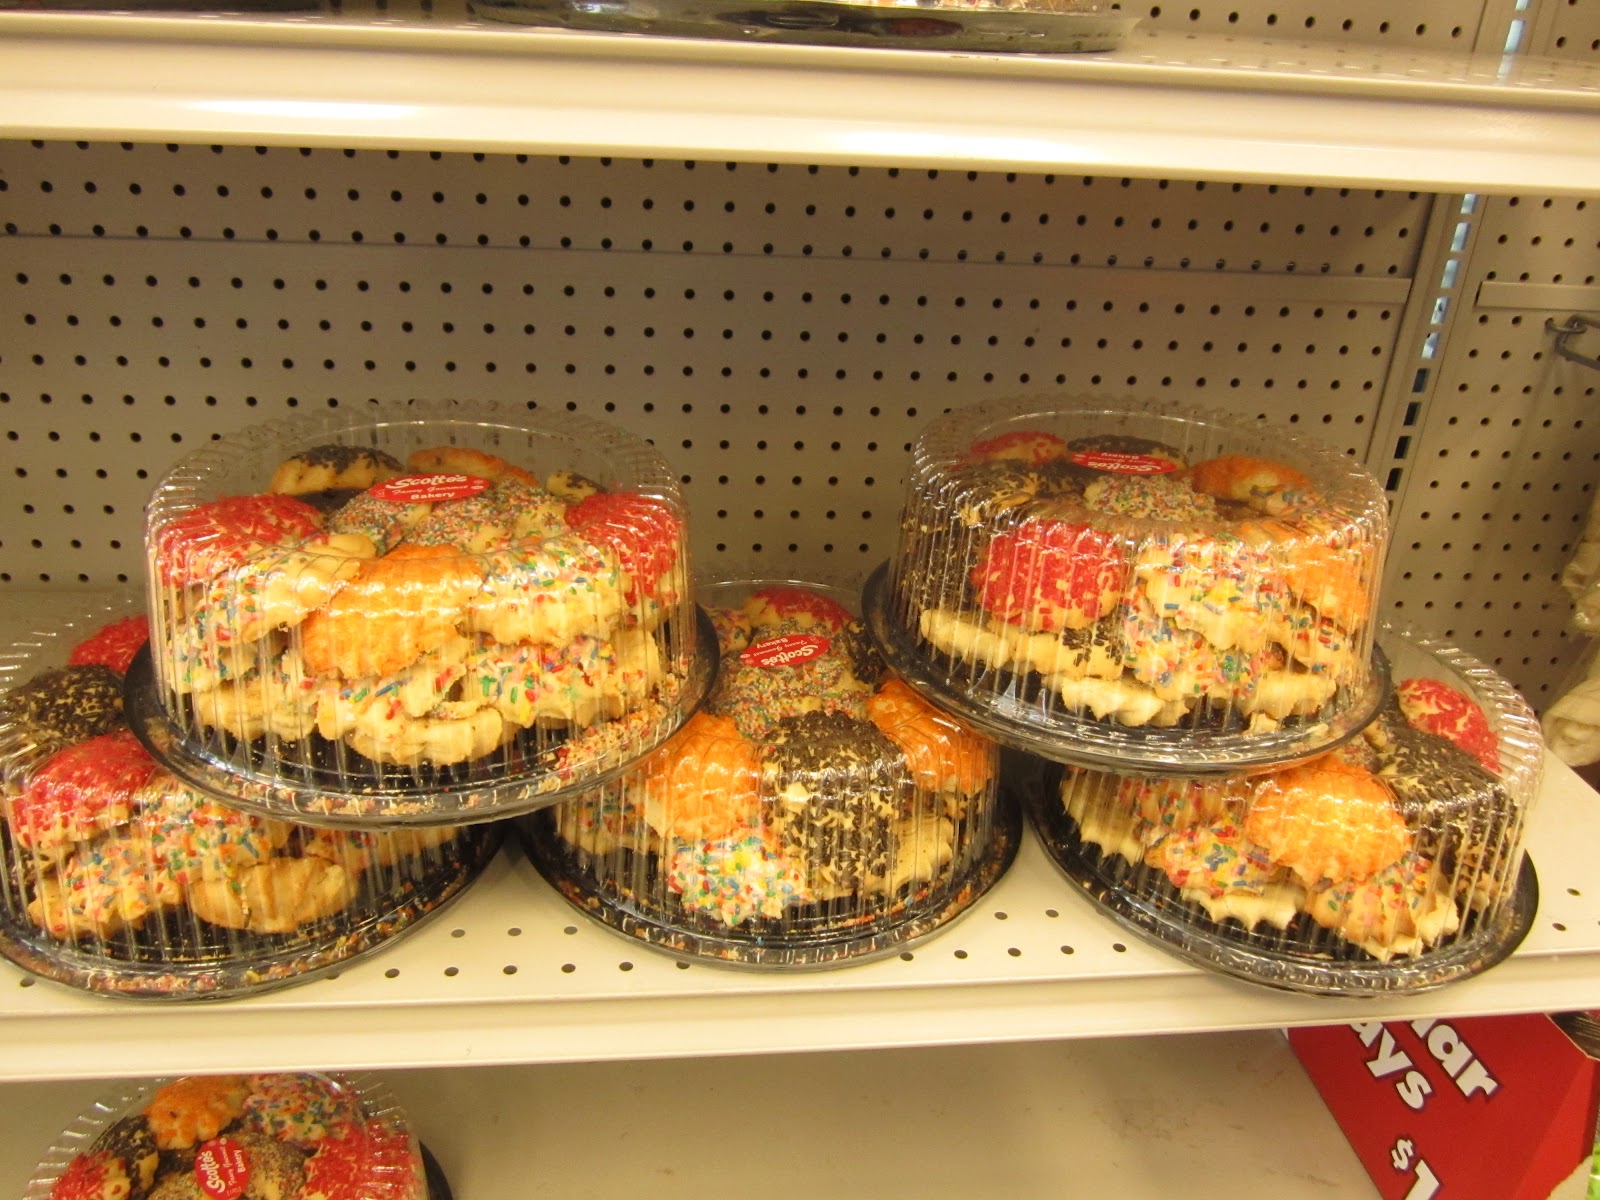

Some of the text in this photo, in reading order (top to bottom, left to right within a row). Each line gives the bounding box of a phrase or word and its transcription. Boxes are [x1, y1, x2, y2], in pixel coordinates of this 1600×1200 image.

[411, 492, 455, 500] Bakery
[757, 638, 788, 648] Bakery
[234, 1150, 246, 1172] Bakery
